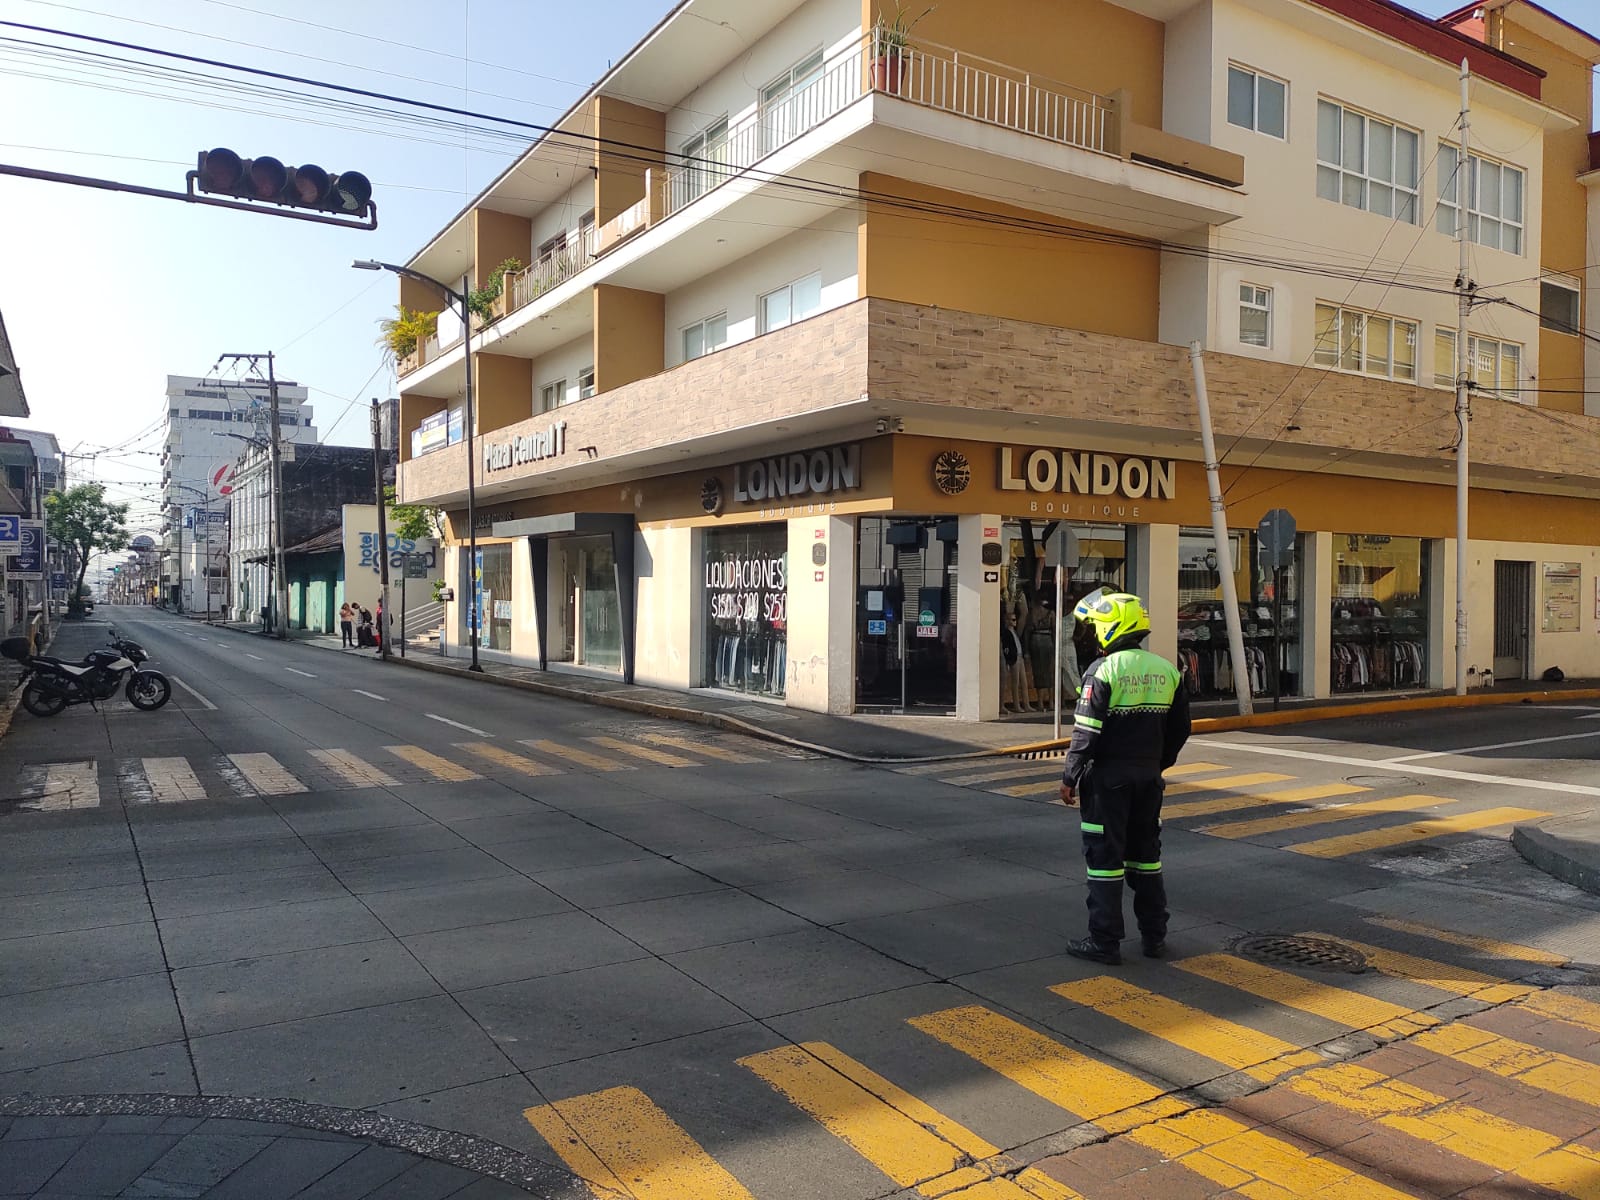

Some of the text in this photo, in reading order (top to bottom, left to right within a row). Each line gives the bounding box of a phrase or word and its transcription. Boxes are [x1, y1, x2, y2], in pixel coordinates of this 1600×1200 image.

[484, 442, 512, 473] Plaza
[512, 424, 555, 465] Central
[734, 444, 862, 502] LONDON
[1001, 446, 1176, 500] LONDON
[759, 502, 836, 518] BOUTIQUE
[1030, 501, 1140, 517] BOUIQUE
[358, 531, 373, 567] hotel
[373, 532, 416, 552] los
[706, 557, 785, 591] LIQUIDACIONES
[711, 591, 787, 622] $150 $200 $250
